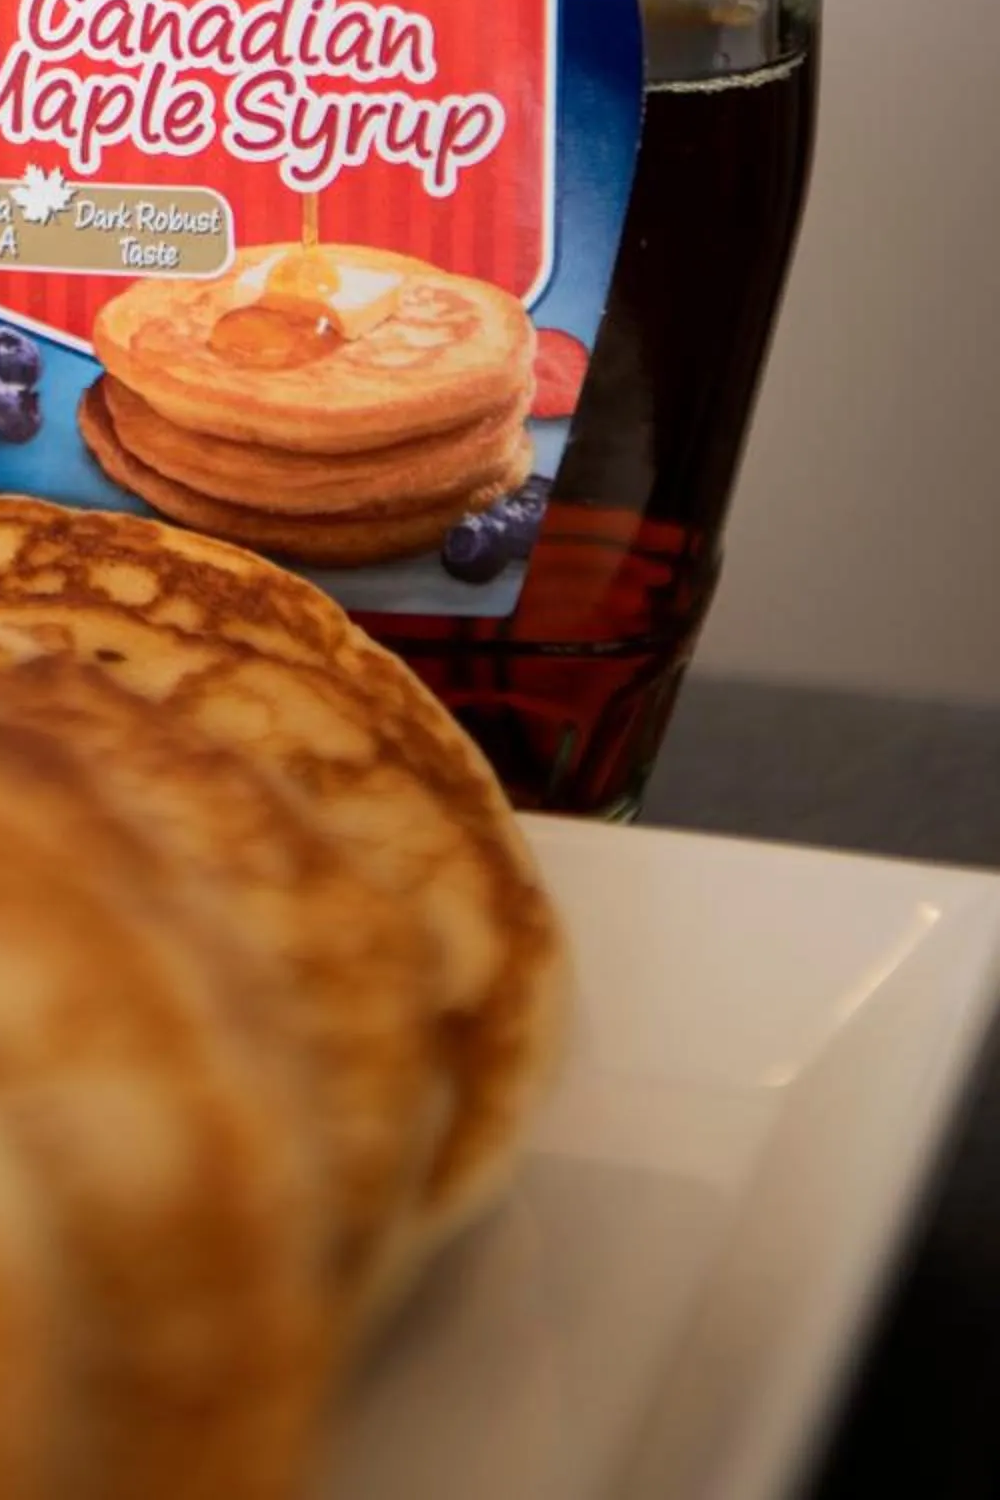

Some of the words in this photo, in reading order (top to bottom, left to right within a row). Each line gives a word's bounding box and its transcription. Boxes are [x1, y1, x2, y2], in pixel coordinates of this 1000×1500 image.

[225, 67, 506, 197] Syrup
[74, 199, 132, 232] Dark
[136, 203, 223, 235] Robust
[119, 234, 180, 269] Taste
